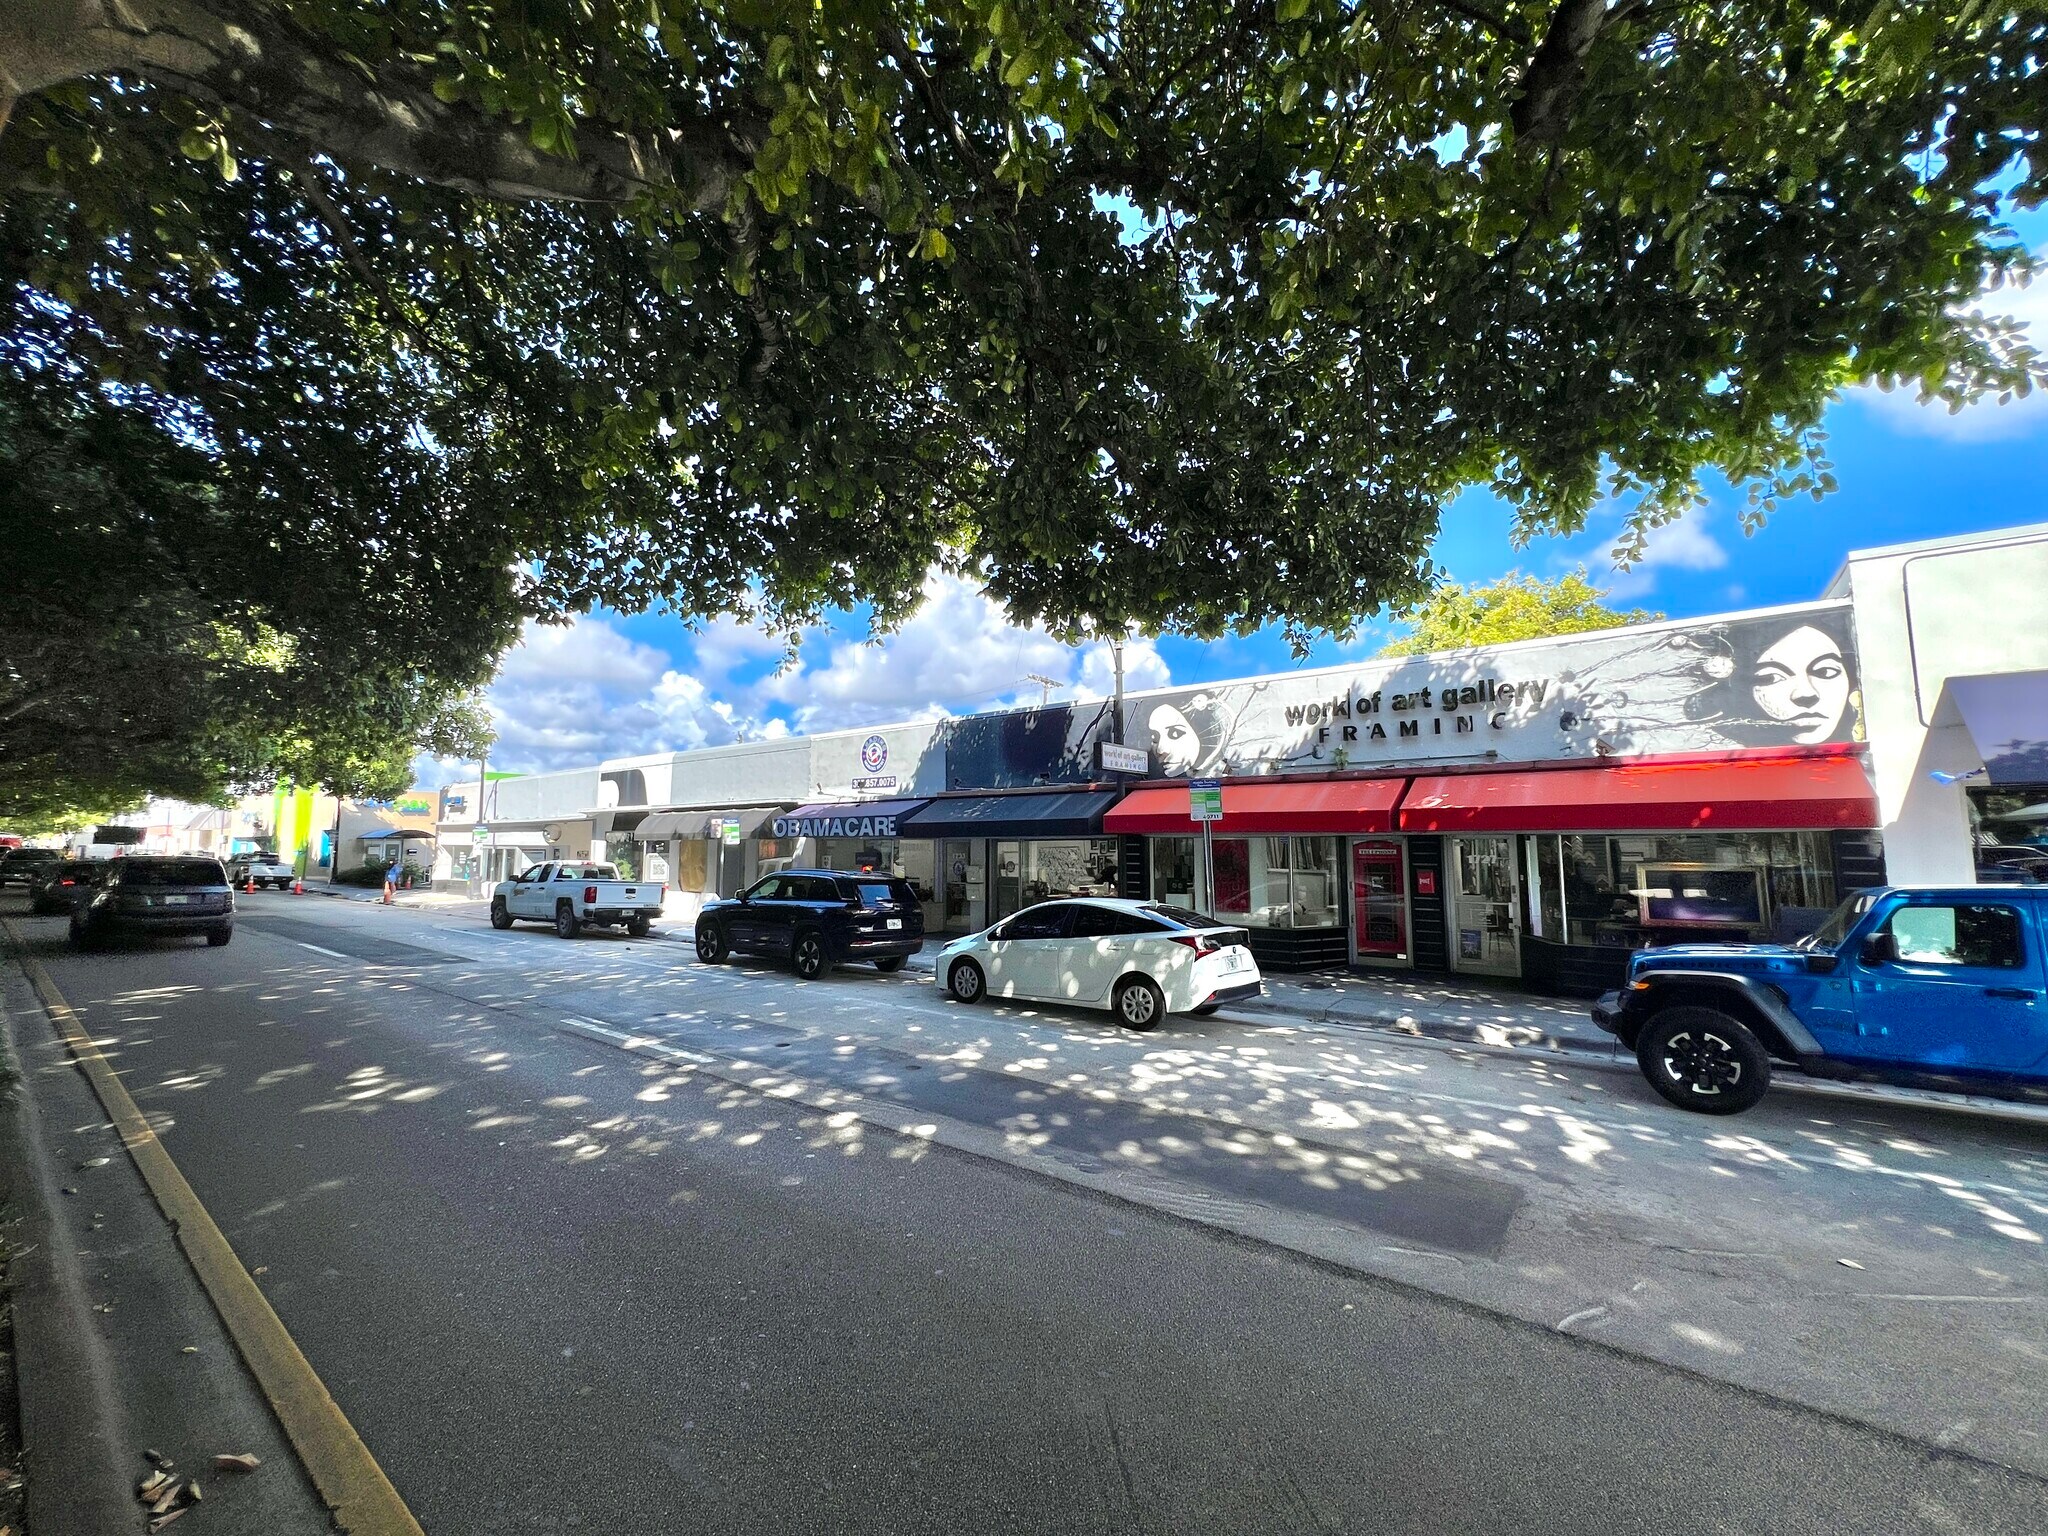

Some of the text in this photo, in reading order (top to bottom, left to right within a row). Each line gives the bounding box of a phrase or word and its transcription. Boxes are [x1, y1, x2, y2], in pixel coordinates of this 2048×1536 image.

[1286, 678, 1549, 723] work of art gallery
[773, 816, 897, 838] OBAMACARE
